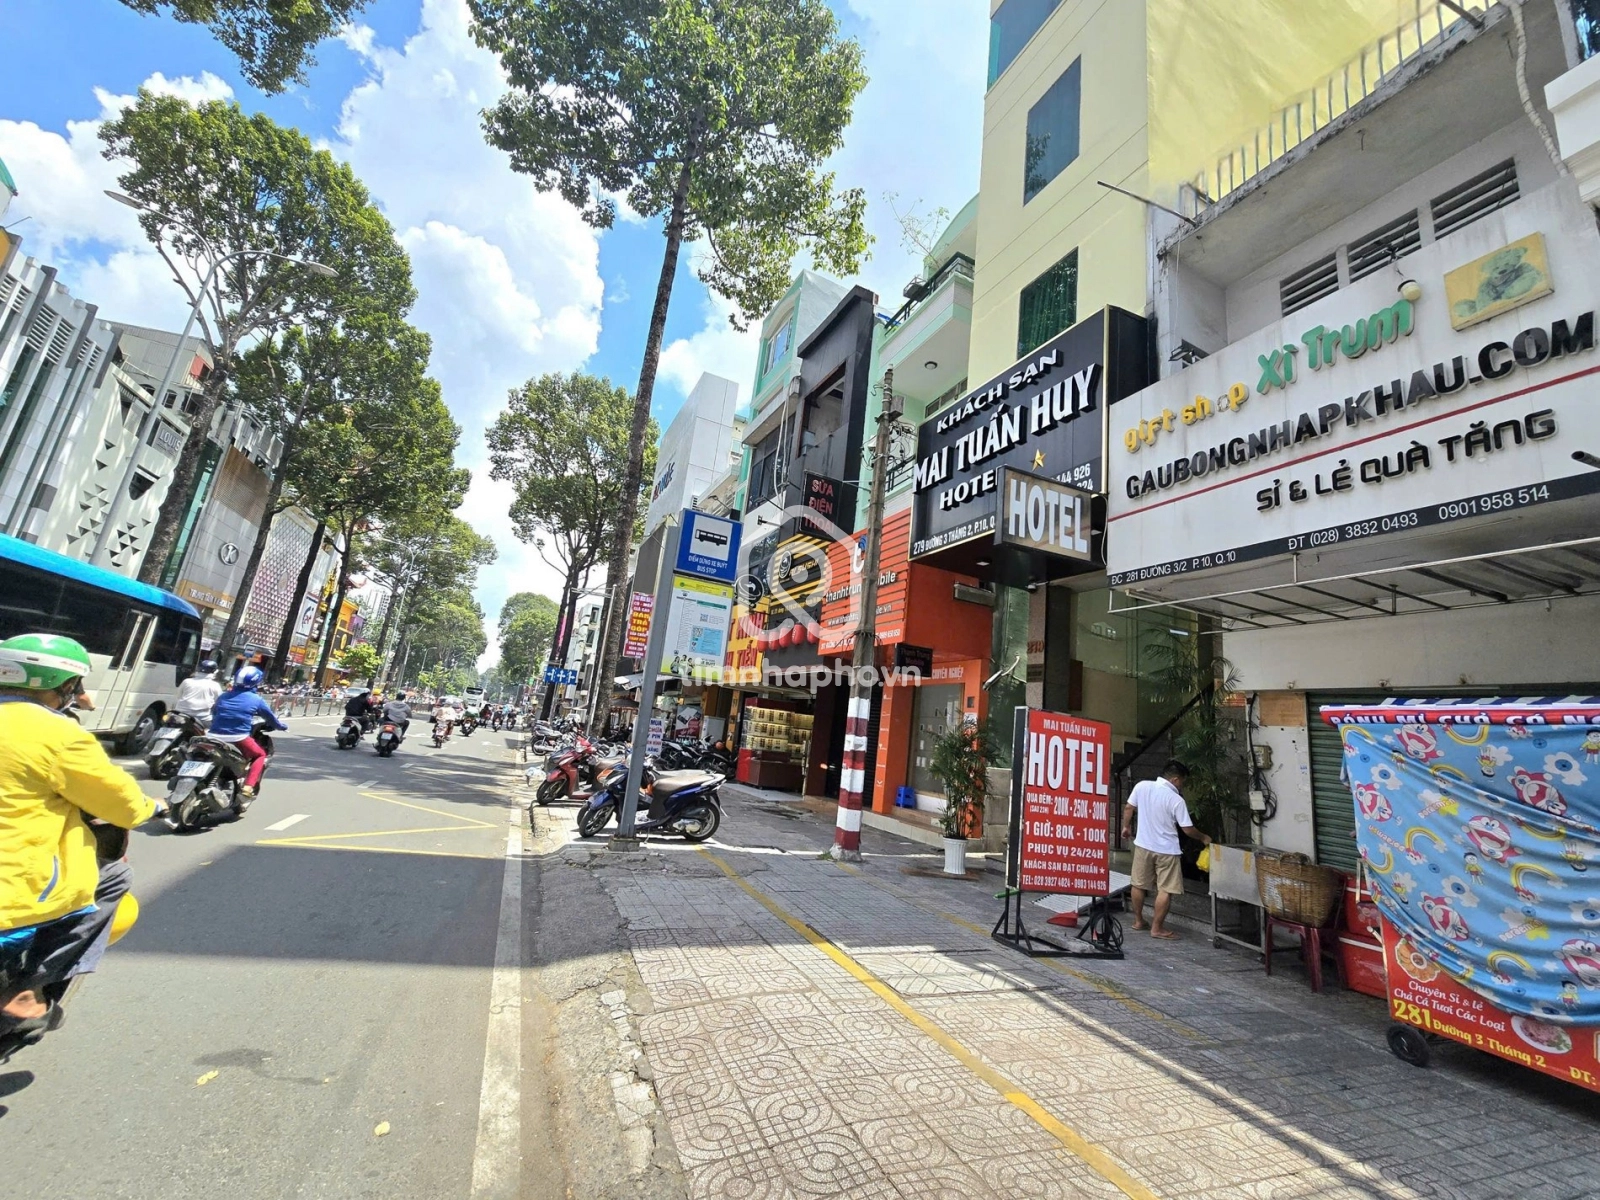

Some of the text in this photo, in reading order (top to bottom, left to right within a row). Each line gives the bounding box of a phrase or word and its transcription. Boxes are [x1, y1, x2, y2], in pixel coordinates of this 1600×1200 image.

[1124, 407, 1176, 453] gift
[1301, 299, 1415, 371] Trum
[937, 348, 1058, 434] KHÁCH SẠN
[160, 429, 181, 451] LOUIS
[913, 362, 1096, 495] MAI TUẤN HUY
[1074, 463, 1091, 481] 926
[1289, 480, 1308, 502] &
[1315, 459, 1353, 495] LẺ
[1360, 440, 1431, 484] QUÀ
[809, 496, 833, 515] ĐIỆN
[1008, 478, 1088, 554] HOTEL
[1288, 484, 1550, 550] ĐT (028) 3832 0493 0901 958 514
[913, 540, 925, 555] 279
[943, 534, 948, 544] 3
[948, 526, 967, 543] THÁNG
[705, 566, 717, 575] STOP
[1111, 574, 1123, 585] ĐC
[1126, 571, 1139, 583] 281
[1173, 562, 1187, 573] 3/2
[1043, 719, 1097, 737] MAI TUẤN HUY
[1027, 732, 1108, 796] HOTEL
[1026, 792, 1037, 803] QUA
[1054, 796, 1069, 816] 200K
[1073, 798, 1088, 818] 250K
[1092, 801, 1107, 820] 300K
[1025, 821, 1030, 835] 1
[1033, 819, 1053, 837] GIỜ:
[1056, 824, 1075, 840] 80K
[1083, 828, 1106, 843] 100K
[1028, 842, 1104, 859] PHỤC VỤ 24/24H
[1023, 858, 1046, 870] KHÁCH
[1048, 862, 1061, 872] SẠN
[1062, 863, 1075, 874] ĐẠT
[1023, 875, 1033, 885] TEL:
[1408, 981, 1446, 1000] Chuyên
[1394, 988, 1506, 1032] Chả Cá Tươi Các Loại
[1393, 999, 1597, 1086] 281 Đường 3 Tháng 2 ĐT:
